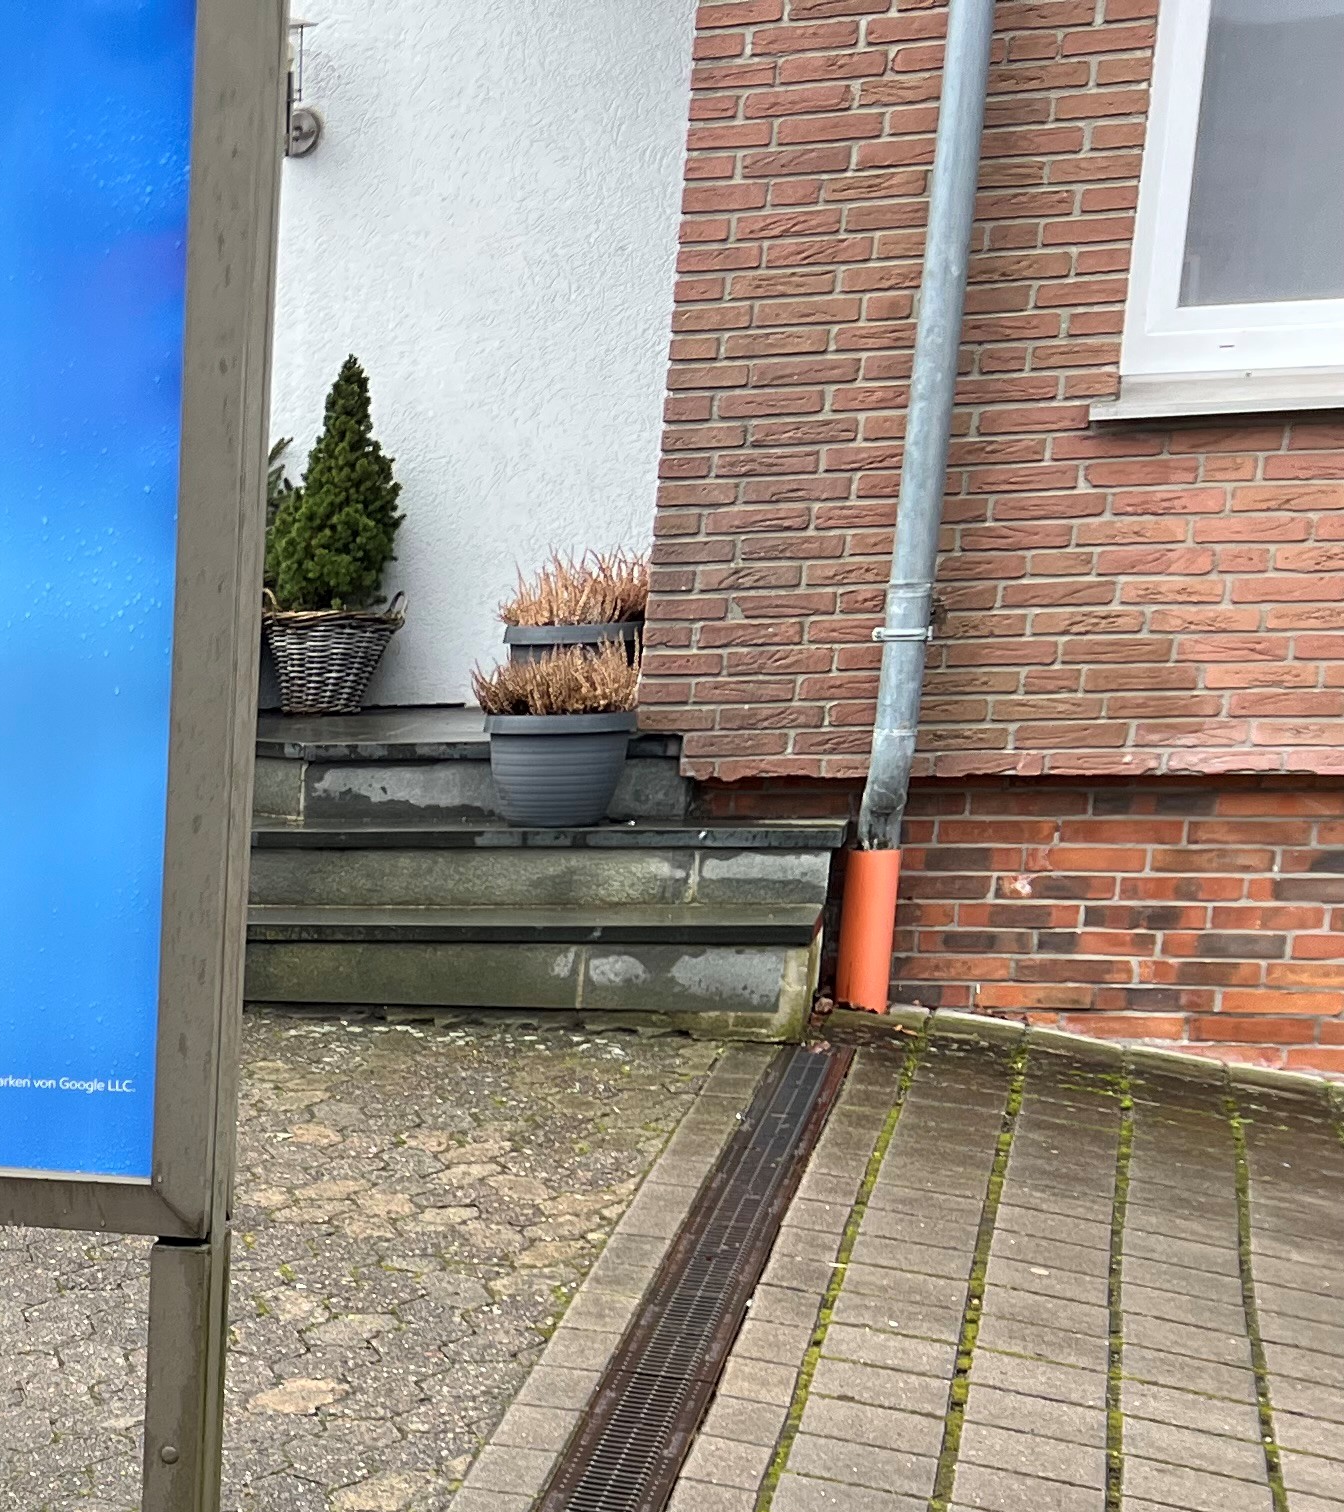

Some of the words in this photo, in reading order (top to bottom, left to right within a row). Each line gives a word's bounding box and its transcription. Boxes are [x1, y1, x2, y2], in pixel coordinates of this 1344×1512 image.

[33, 1078, 56, 1090] von
[59, 1076, 105, 1095] Google
[108, 1078, 136, 1093] LLC.
